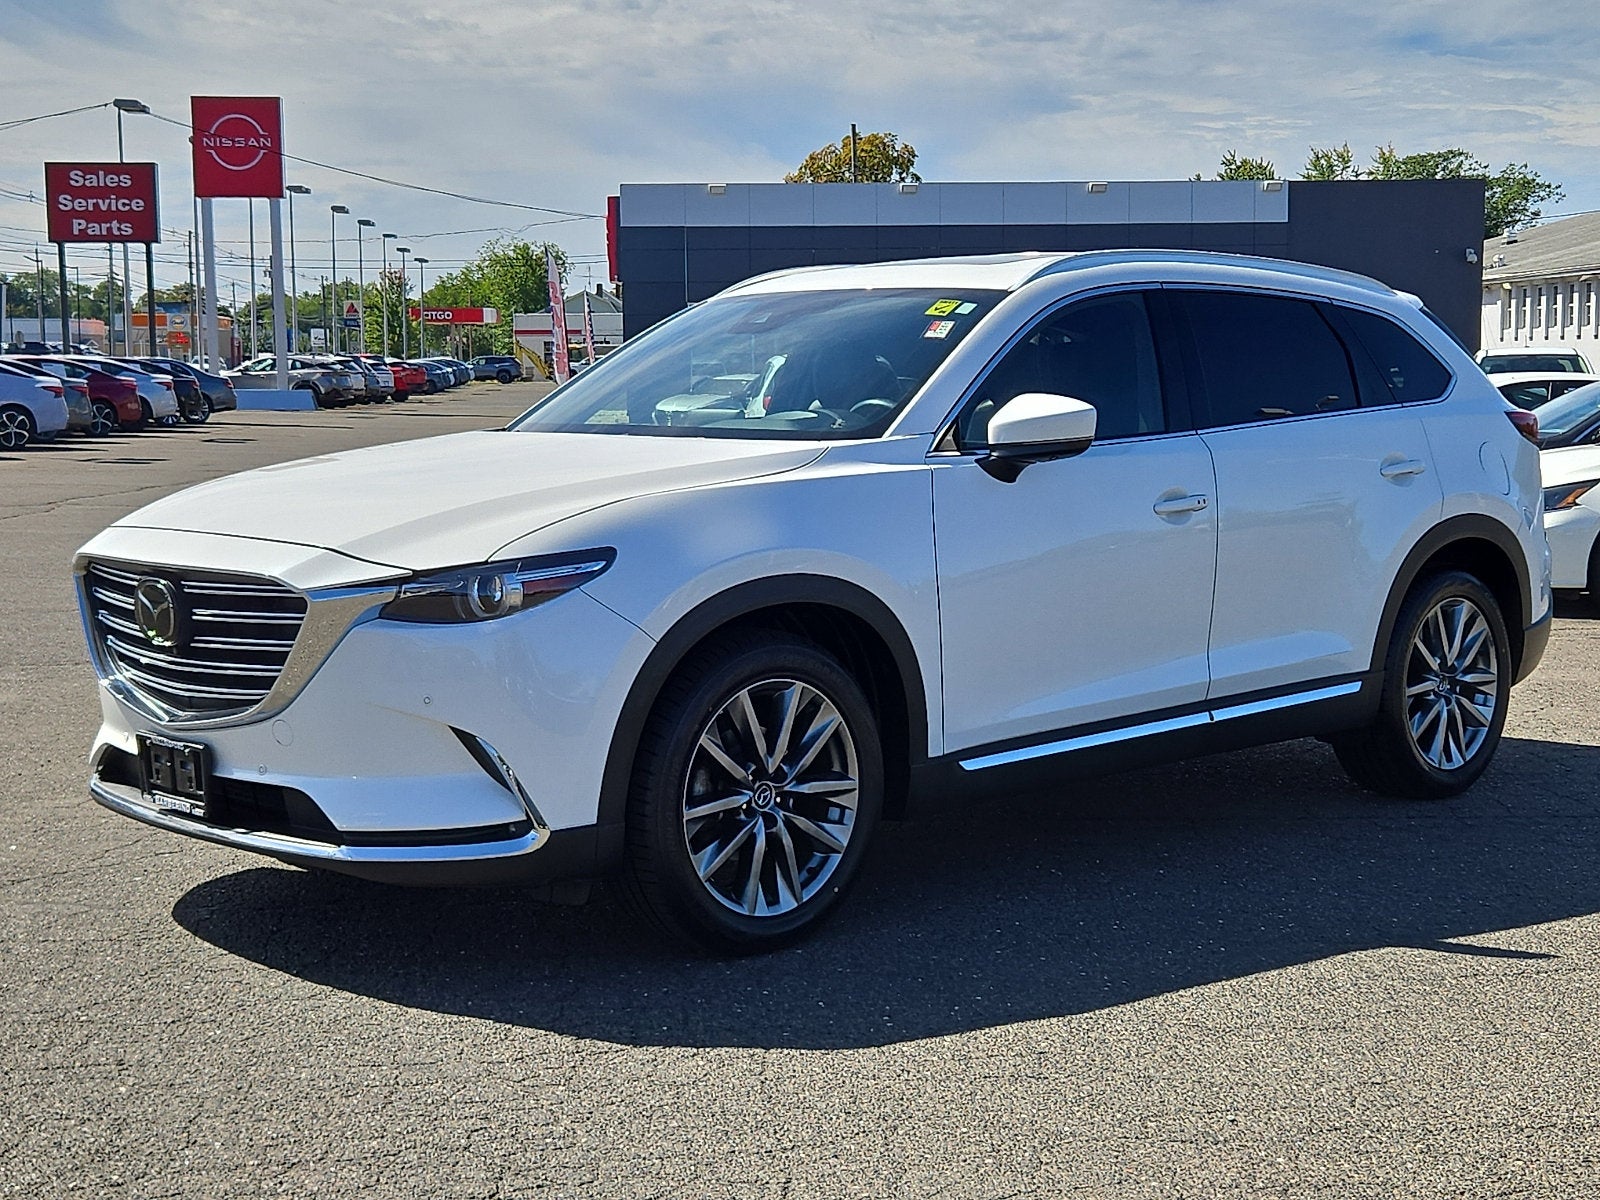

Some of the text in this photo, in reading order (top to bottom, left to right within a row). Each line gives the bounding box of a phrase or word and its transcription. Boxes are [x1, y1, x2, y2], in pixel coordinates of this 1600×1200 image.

[203, 137, 272, 147] NISSAN
[69, 170, 132, 187] Sales
[57, 195, 145, 211] Service
[72, 219, 133, 235] Parts
